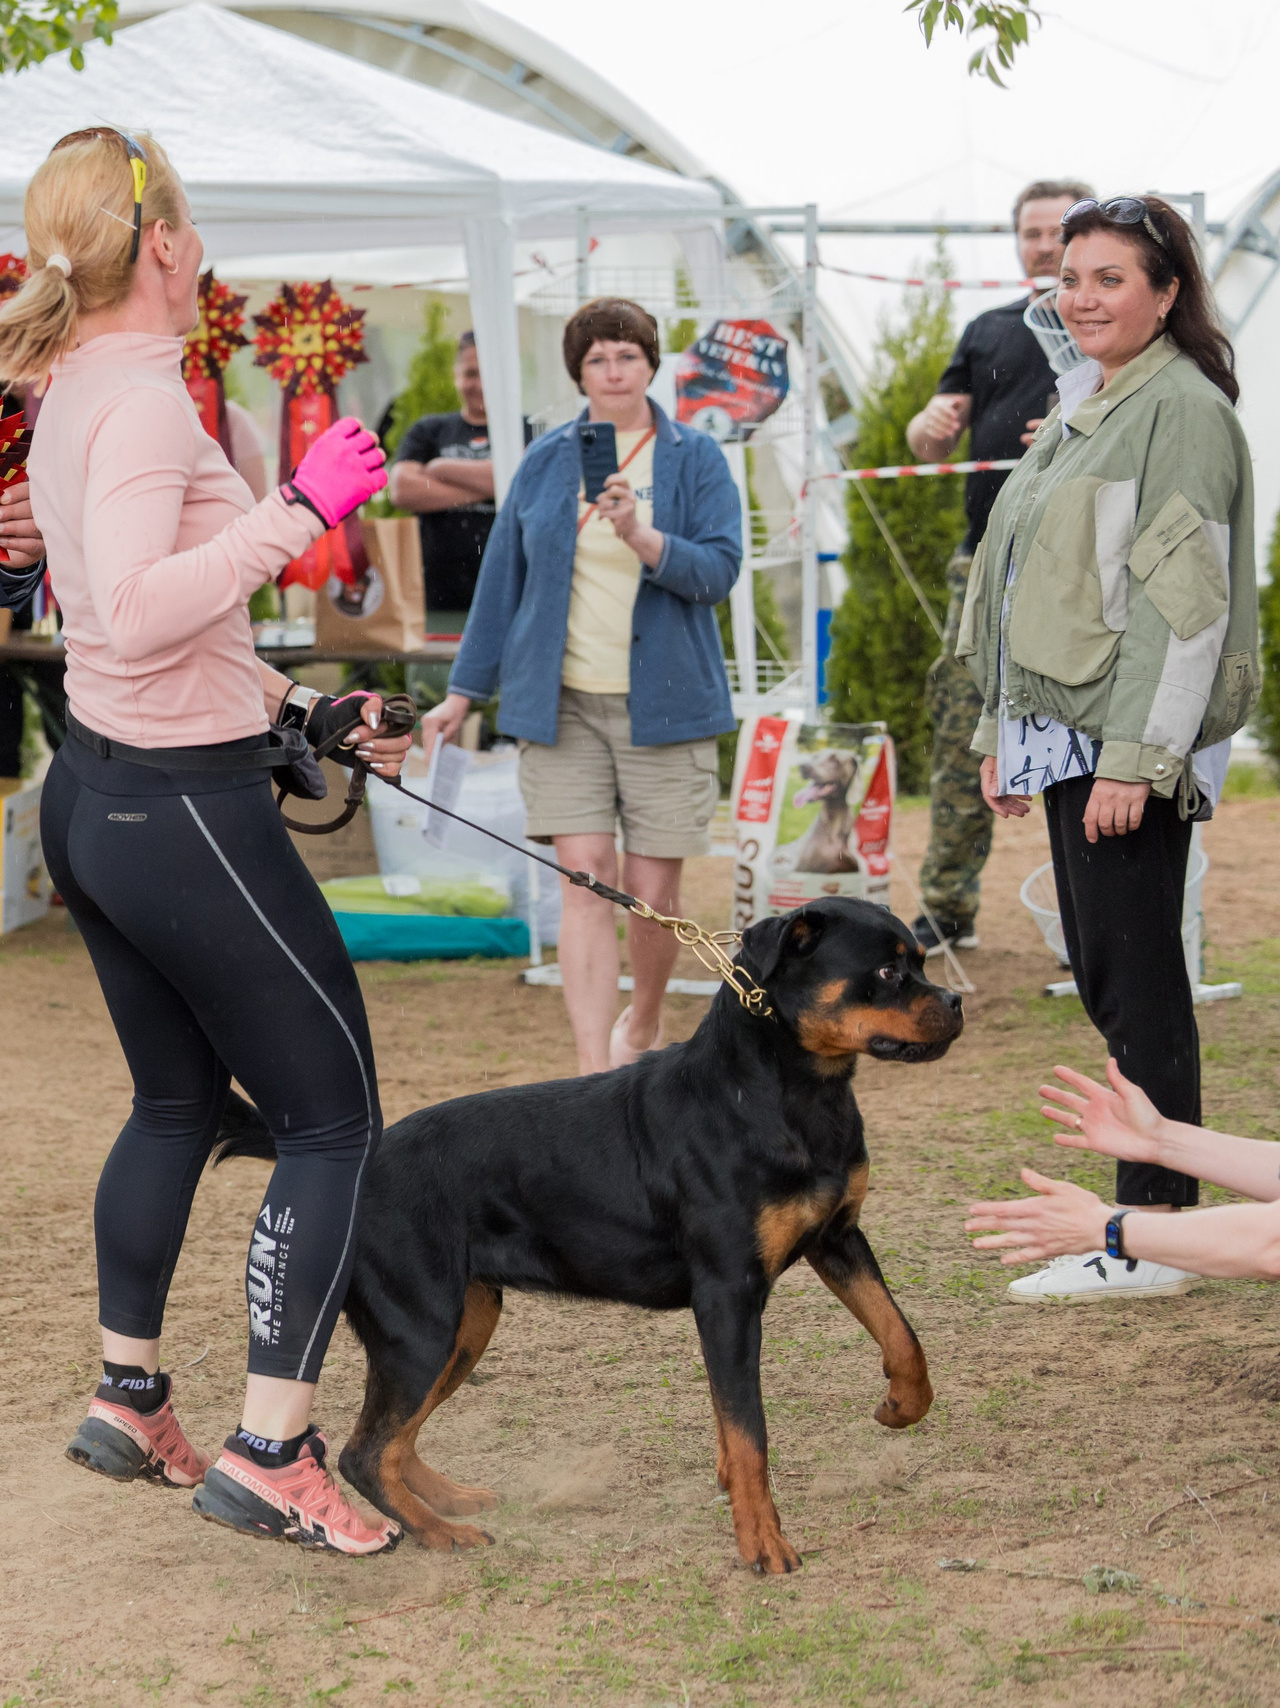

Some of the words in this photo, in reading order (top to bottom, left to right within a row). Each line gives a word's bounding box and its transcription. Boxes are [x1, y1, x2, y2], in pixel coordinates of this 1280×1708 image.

[714, 323, 785, 357] BEST
[699, 340, 782, 377] VETERAN
[286, 1217, 295, 1234] TEAM
[248, 1229, 277, 1346] RUN
[274, 1242, 289, 1312] DISTANCE
[271, 1319, 282, 1345] THE
[117, 1376, 156, 1391] FIDE
[112, 1415, 138, 1434] SPEED
[237, 1430, 284, 1455] FIDE
[219, 1460, 281, 1505] SALOMON
